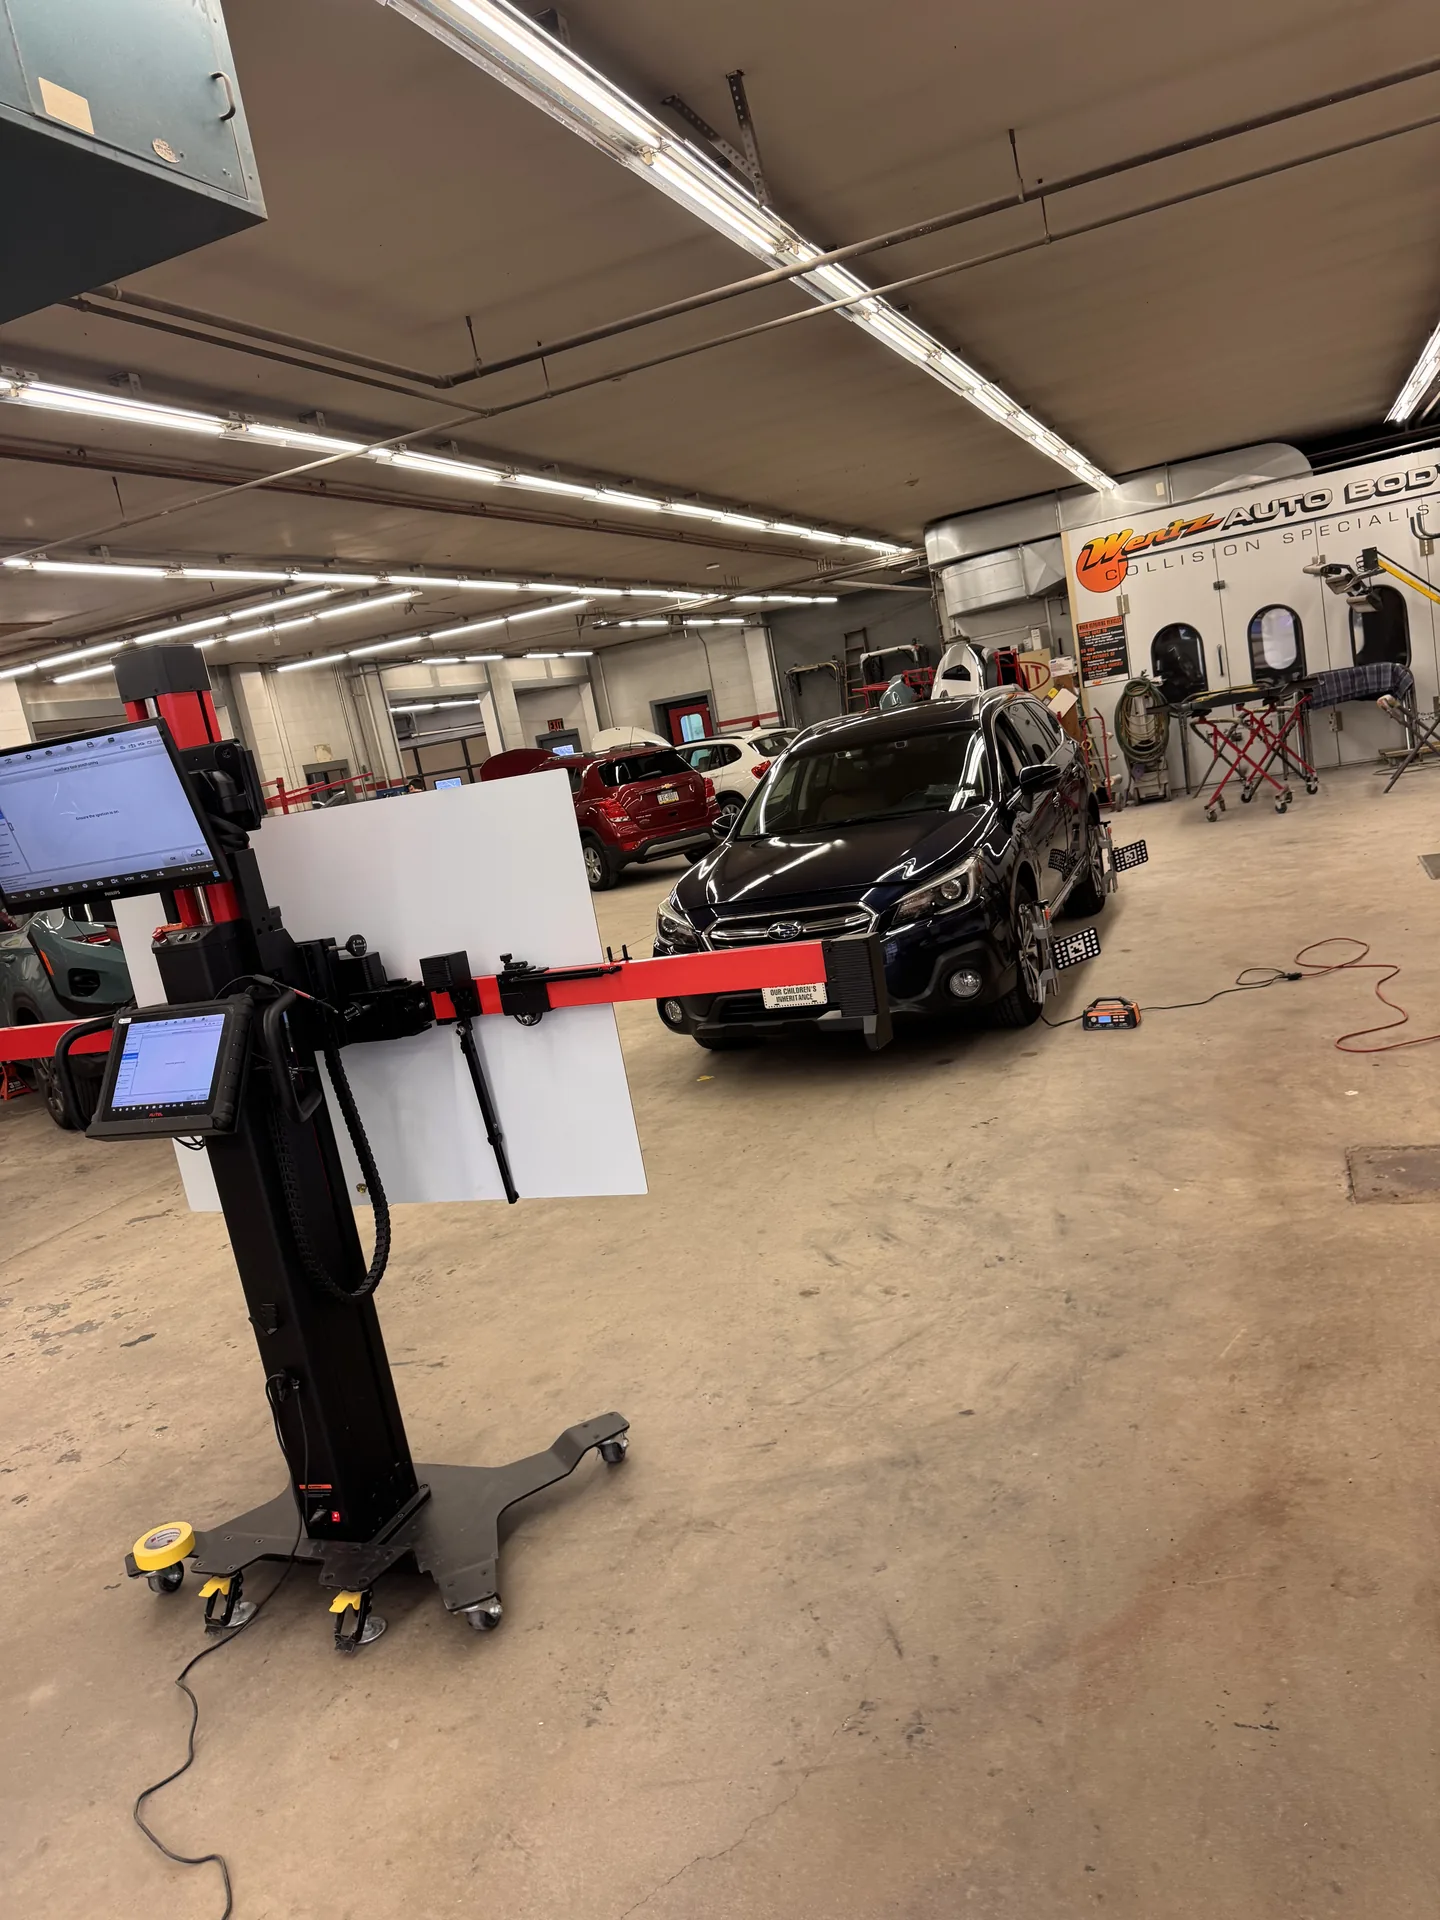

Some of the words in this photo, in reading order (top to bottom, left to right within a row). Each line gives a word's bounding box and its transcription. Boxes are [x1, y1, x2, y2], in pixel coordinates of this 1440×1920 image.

[1082, 513, 1223, 571] Wentz
[1221, 488, 1333, 532] AUTO
[1344, 463, 1440, 504] BOD
[1105, 539, 1260, 581] COLLISION
[1282, 502, 1440, 544] SPECIALIS
[549, 720, 562, 731] EXIT
[783, 985, 817, 995] CHILDREN'S
[776, 993, 813, 1002] INHERITANCE
